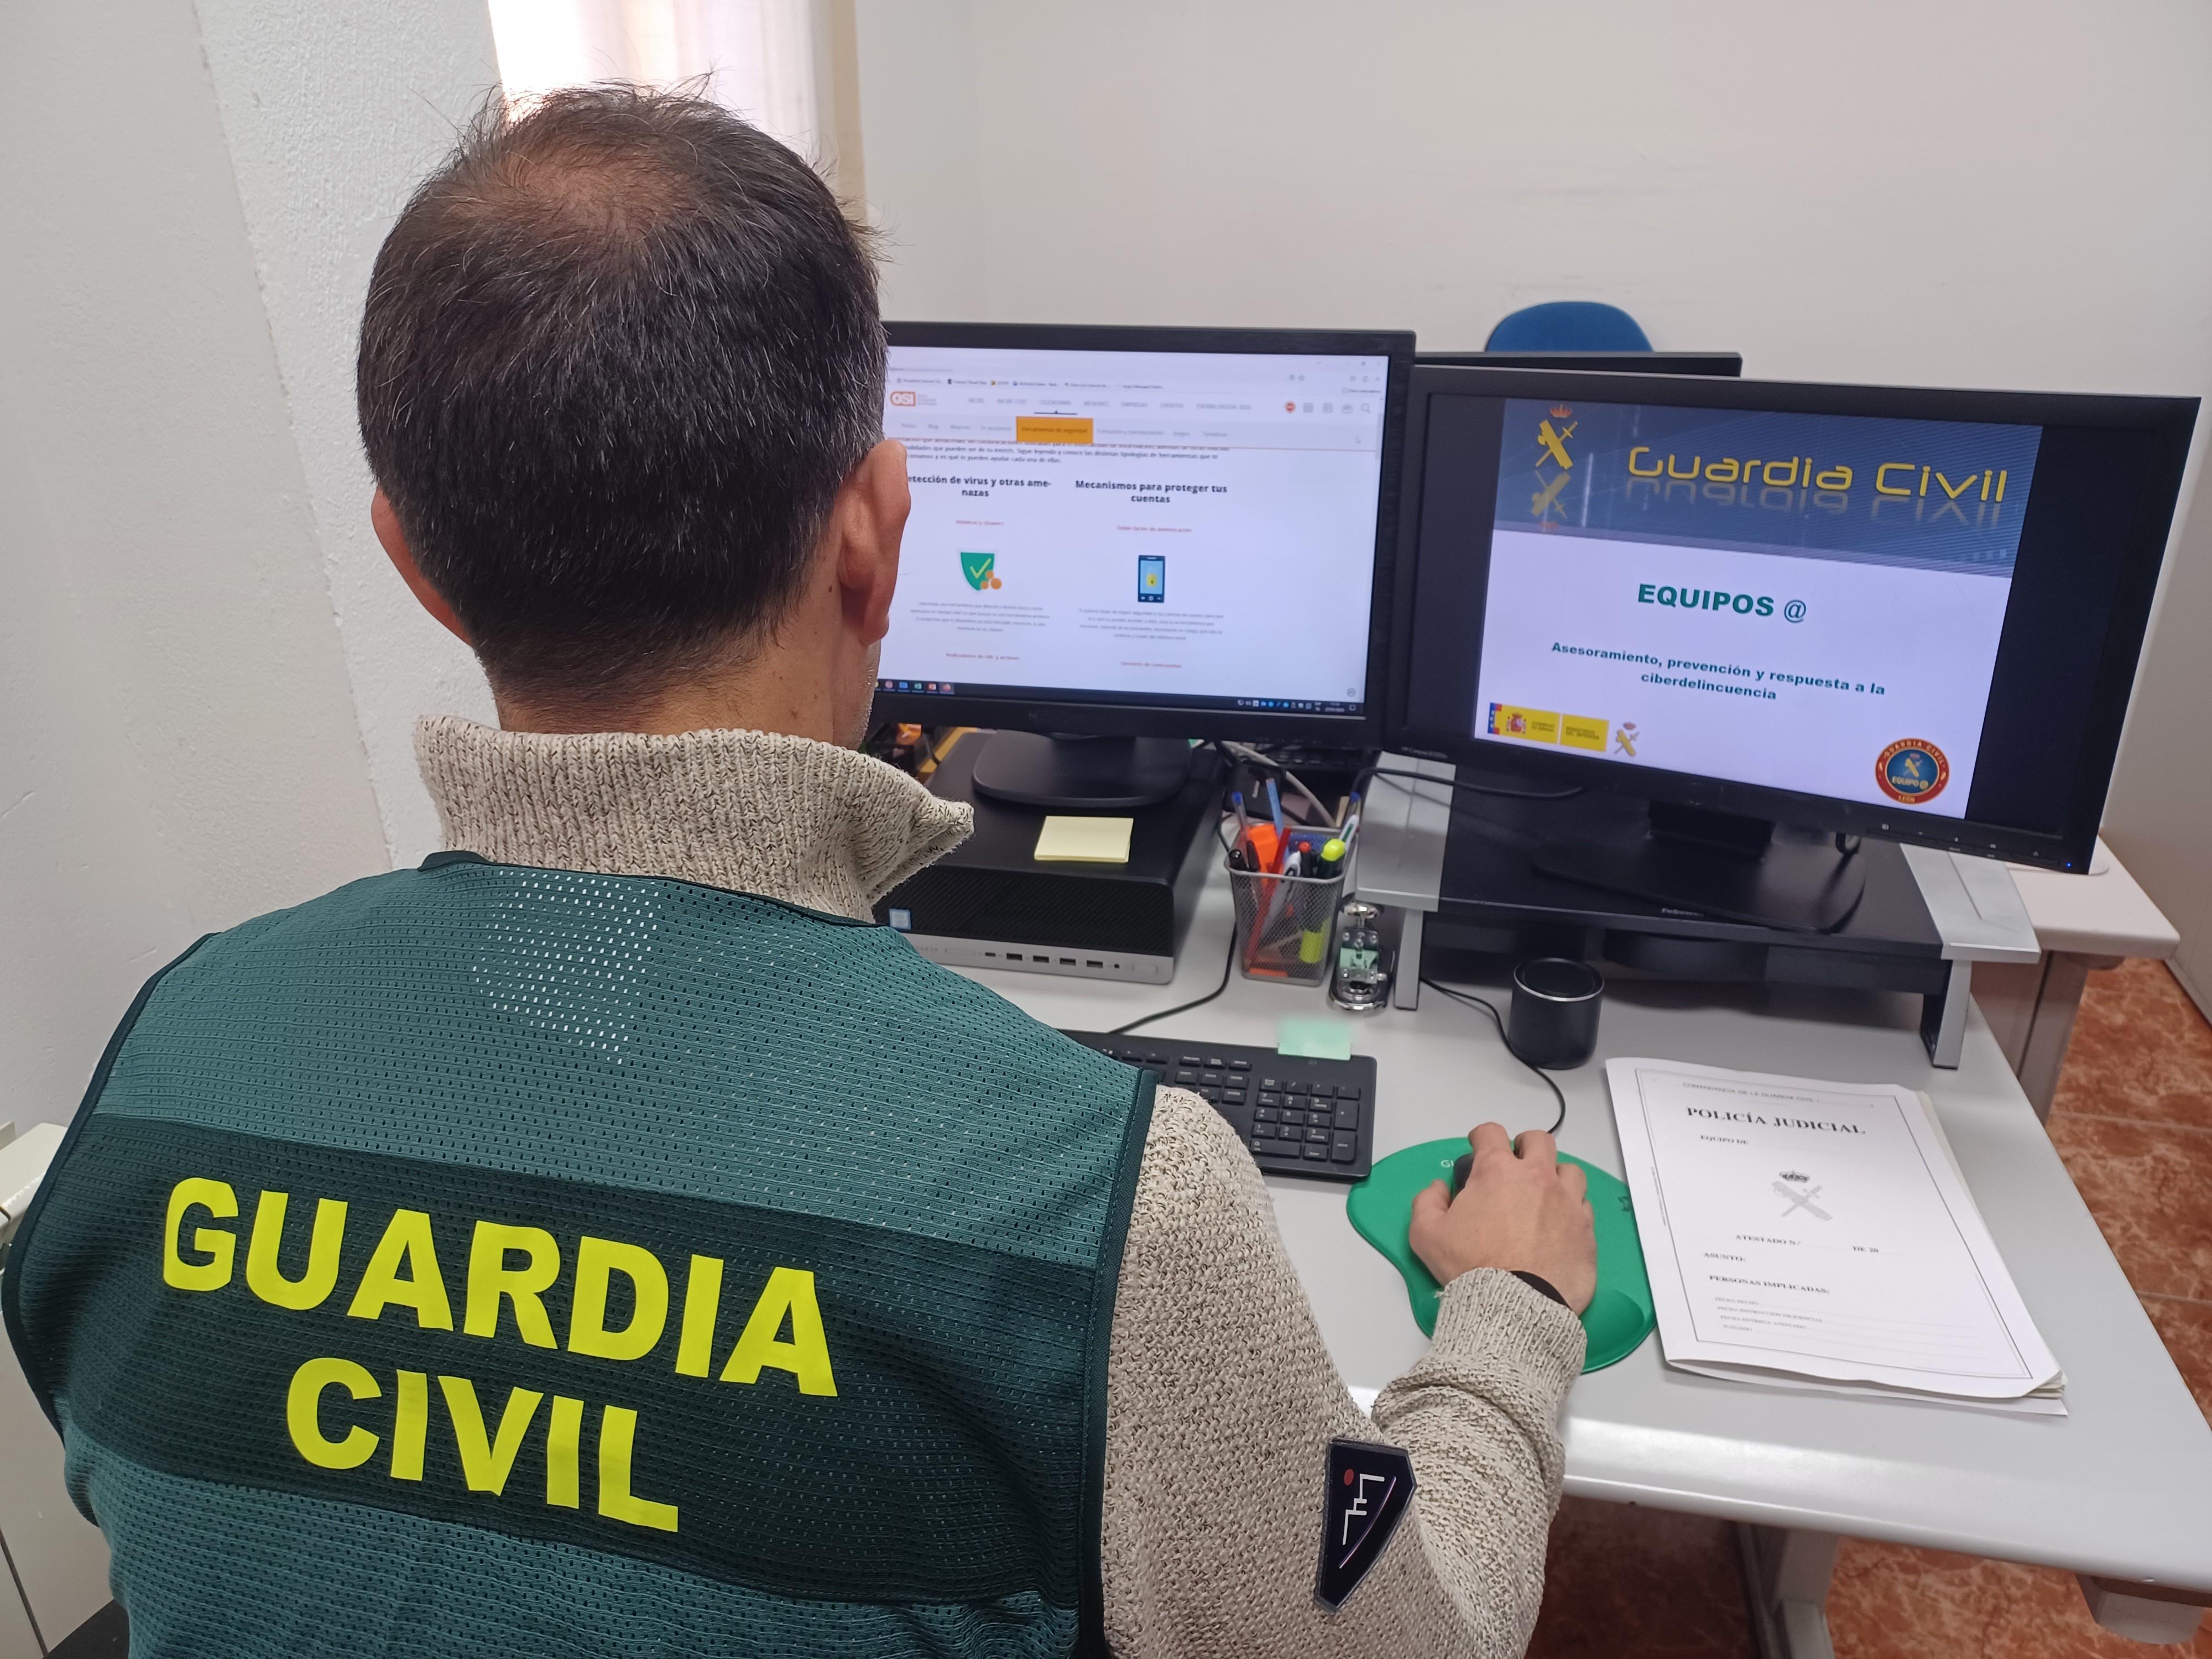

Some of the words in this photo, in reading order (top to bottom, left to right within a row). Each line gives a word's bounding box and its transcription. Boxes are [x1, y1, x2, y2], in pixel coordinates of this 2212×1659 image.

[907, 474, 947, 484] etección
[950, 476, 962, 484] de
[964, 477, 989, 486] virus
[990, 479, 997, 488] y
[999, 478, 1025, 487] otras
[1629, 446, 1854, 492] Guardia
[1875, 462, 2008, 503] Civil
[961, 489, 989, 497] nazas
[1075, 480, 1138, 491] Mecanismos
[1140, 483, 1162, 493] para
[1165, 484, 1209, 494] proteger
[1130, 495, 1171, 503] cuentas
[1637, 583, 1775, 618] EQUIPOS
[1783, 599, 1808, 624] @
[1551, 641, 1663, 667] Asesoramiento,
[1667, 656, 1751, 679] prevención
[1756, 668, 1766, 682] y
[1769, 670, 1850, 693] respuesta
[1855, 683, 1866, 693] a
[1870, 681, 1886, 696] la
[1640, 671, 1777, 701] ciberdelincuencia
[1884, 739, 1922, 758] GUARDIA
[1687, 1106, 1767, 1125] POLICÍA
[1773, 1117, 1866, 1135] JUDICIAL
[1700, 1134, 1735, 1145] EQUIPO
[1735, 1234, 1787, 1245] ATESTADO
[1852, 1245, 1867, 1253] DE
[1703, 1251, 1746, 1262] ASUNTO:
[163, 1176, 838, 1397] GUARDIA
[1709, 1274, 1762, 1287] PERSONAS
[1763, 1281, 1830, 1295] IMPLICADAS:
[285, 1357, 679, 1533] CIVIL
